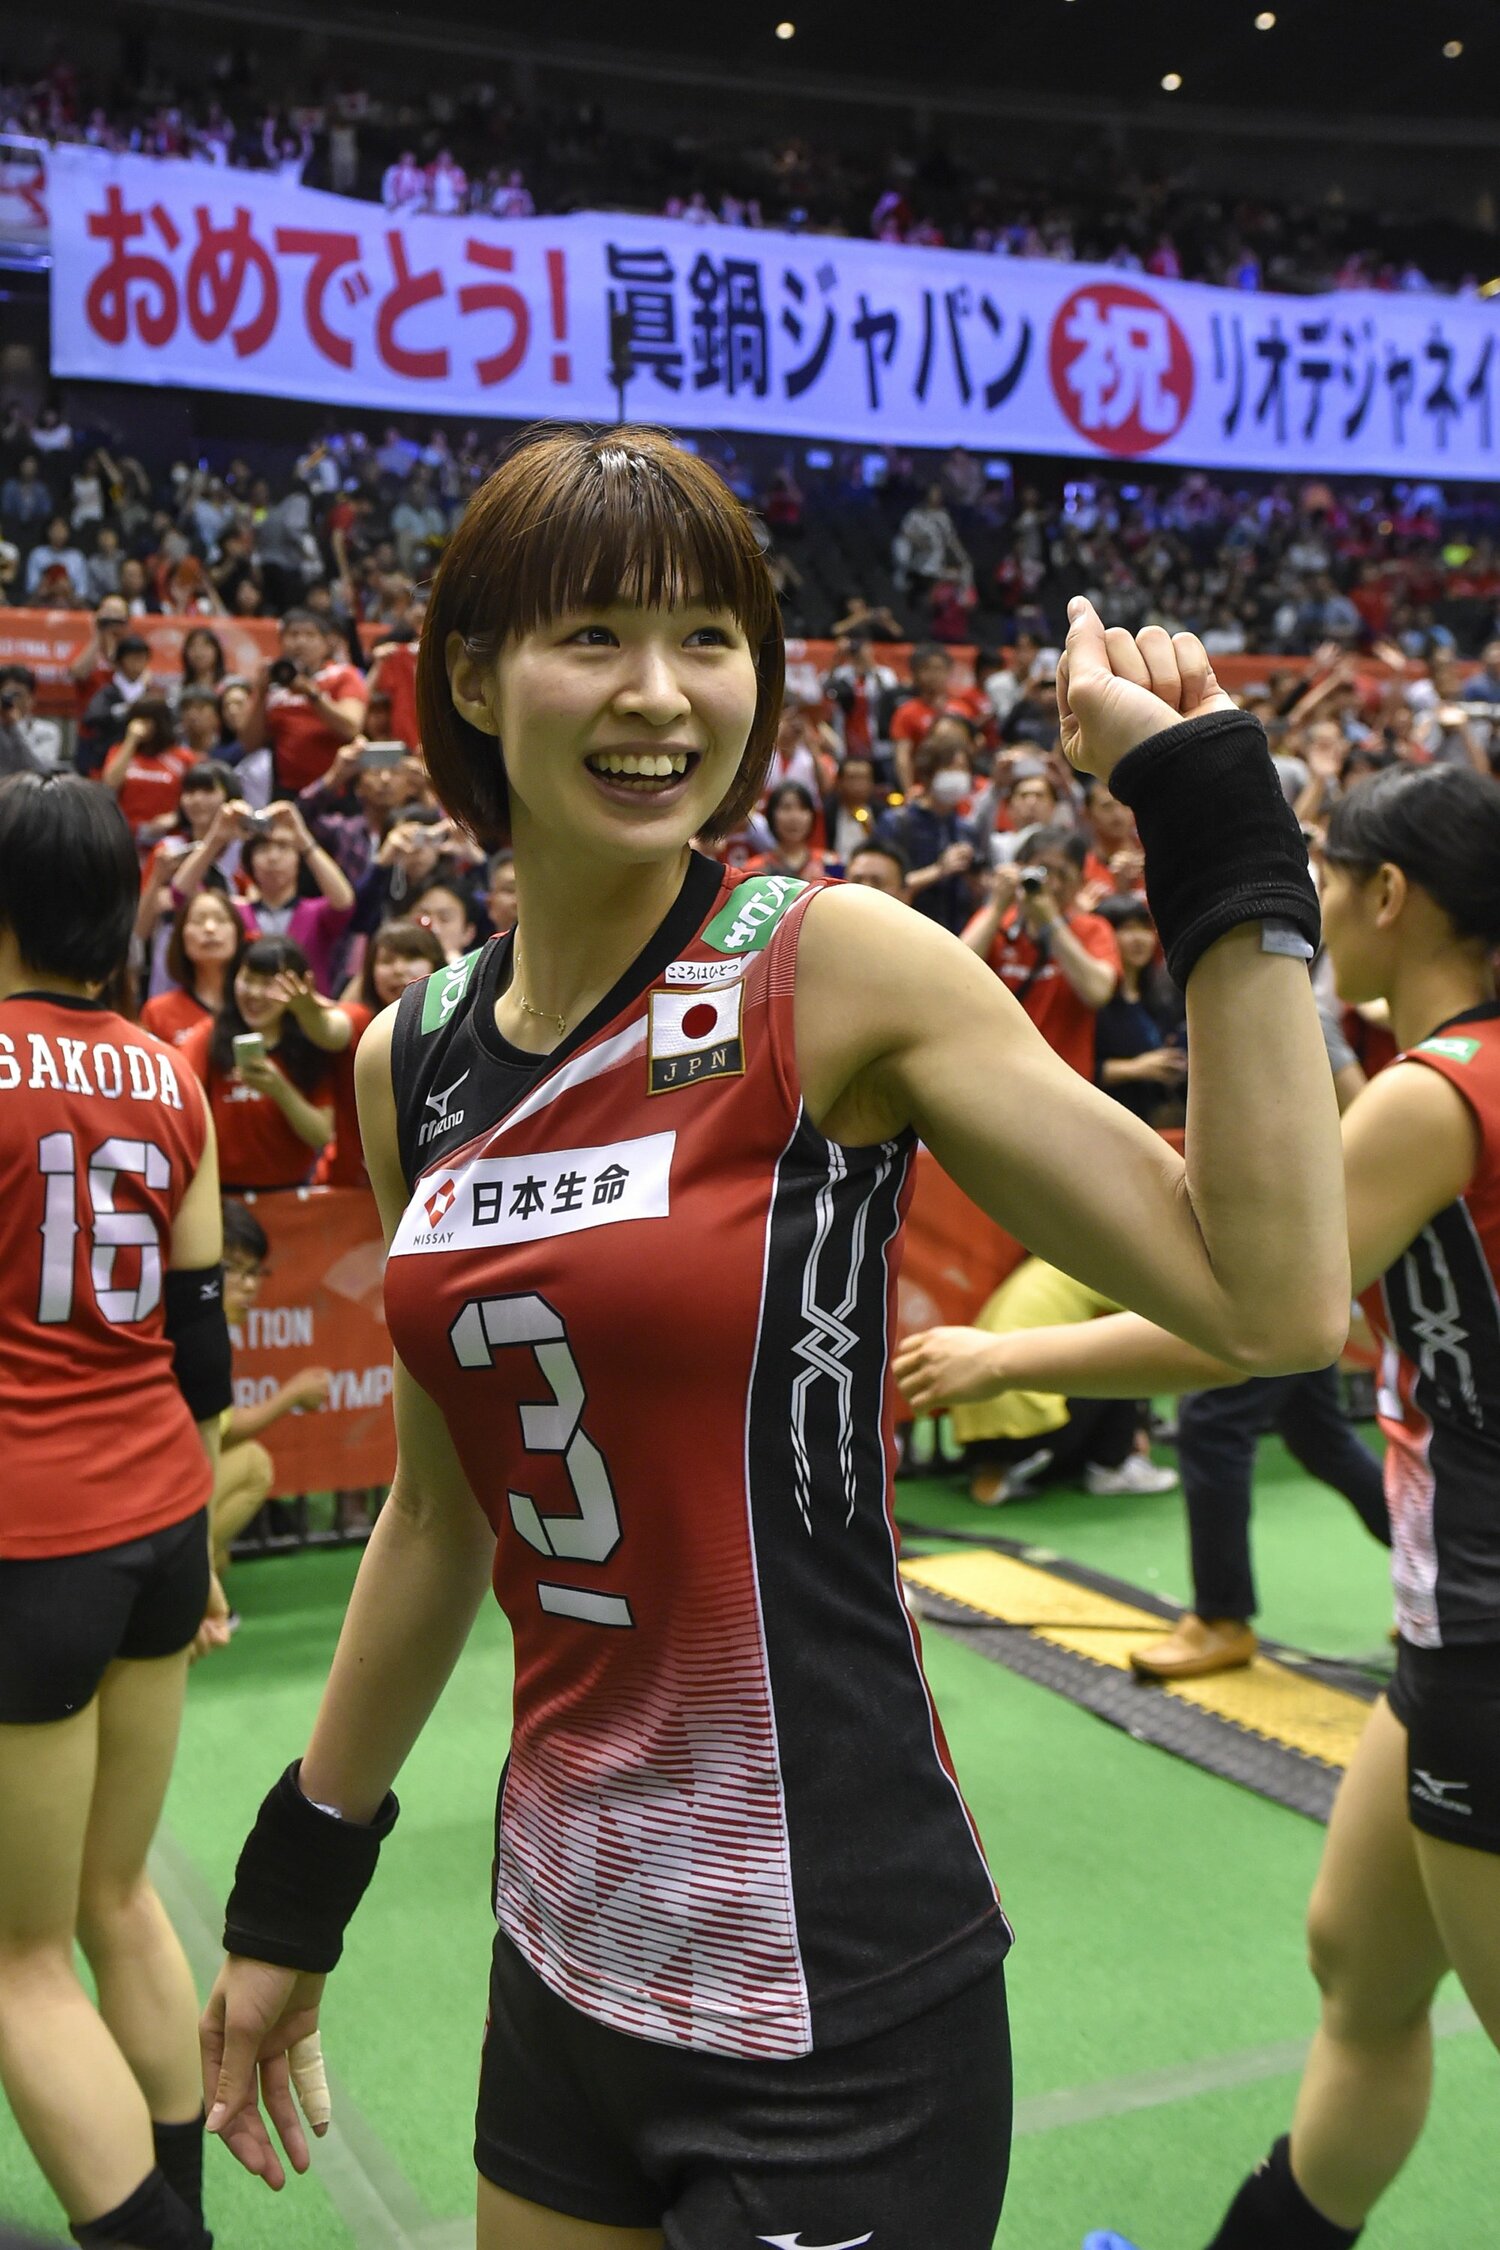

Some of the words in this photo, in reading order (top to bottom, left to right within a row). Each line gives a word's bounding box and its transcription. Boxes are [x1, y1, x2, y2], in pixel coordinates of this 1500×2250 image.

[1065, 297, 1178, 435] 祝
[667, 963, 739, 981] こころはひとつ
[0, 1033, 184, 1110] SAKODA
[663, 1048, 727, 1082] JPN
[38, 1130, 172, 1325] 16
[471, 1162, 630, 1227] 日本生命
[412, 1231, 455, 1246] NISSAY
[447, 1289, 625, 1567] 3
